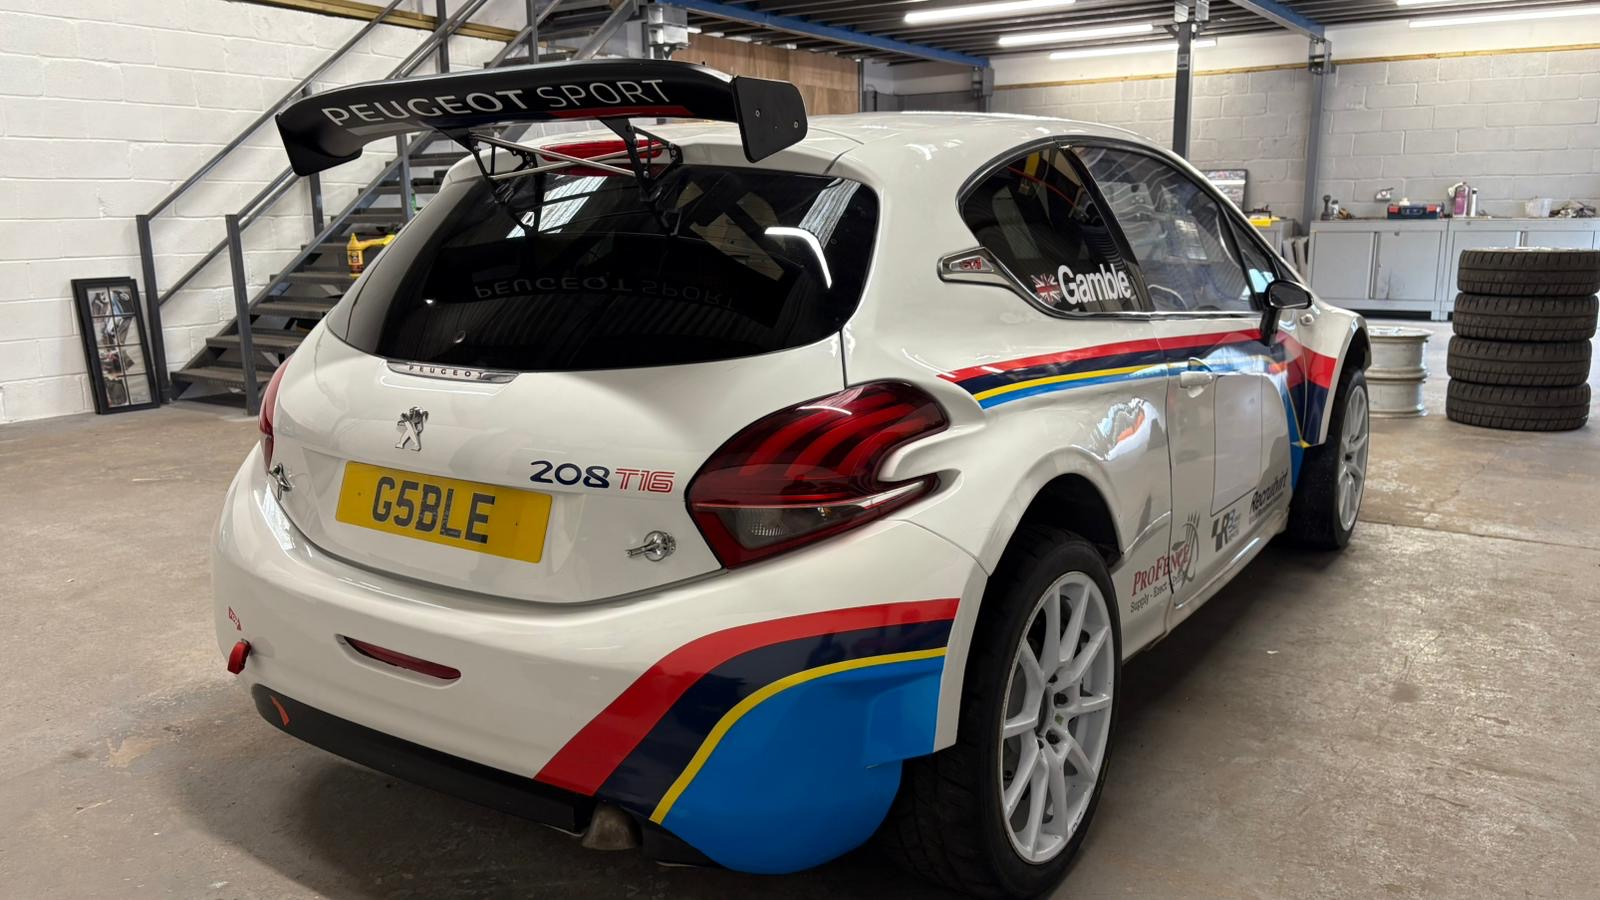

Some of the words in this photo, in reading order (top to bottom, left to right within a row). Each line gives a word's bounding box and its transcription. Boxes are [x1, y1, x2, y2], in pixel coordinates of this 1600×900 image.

[321, 89, 529, 127] PEUGEOT
[536, 79, 671, 108] SPORT
[1057, 264, 1132, 304] Gamble
[408, 364, 483, 380] PEUGEOT
[530, 460, 610, 488] 208
[615, 467, 676, 493] T16
[371, 476, 496, 544] G5BLE
